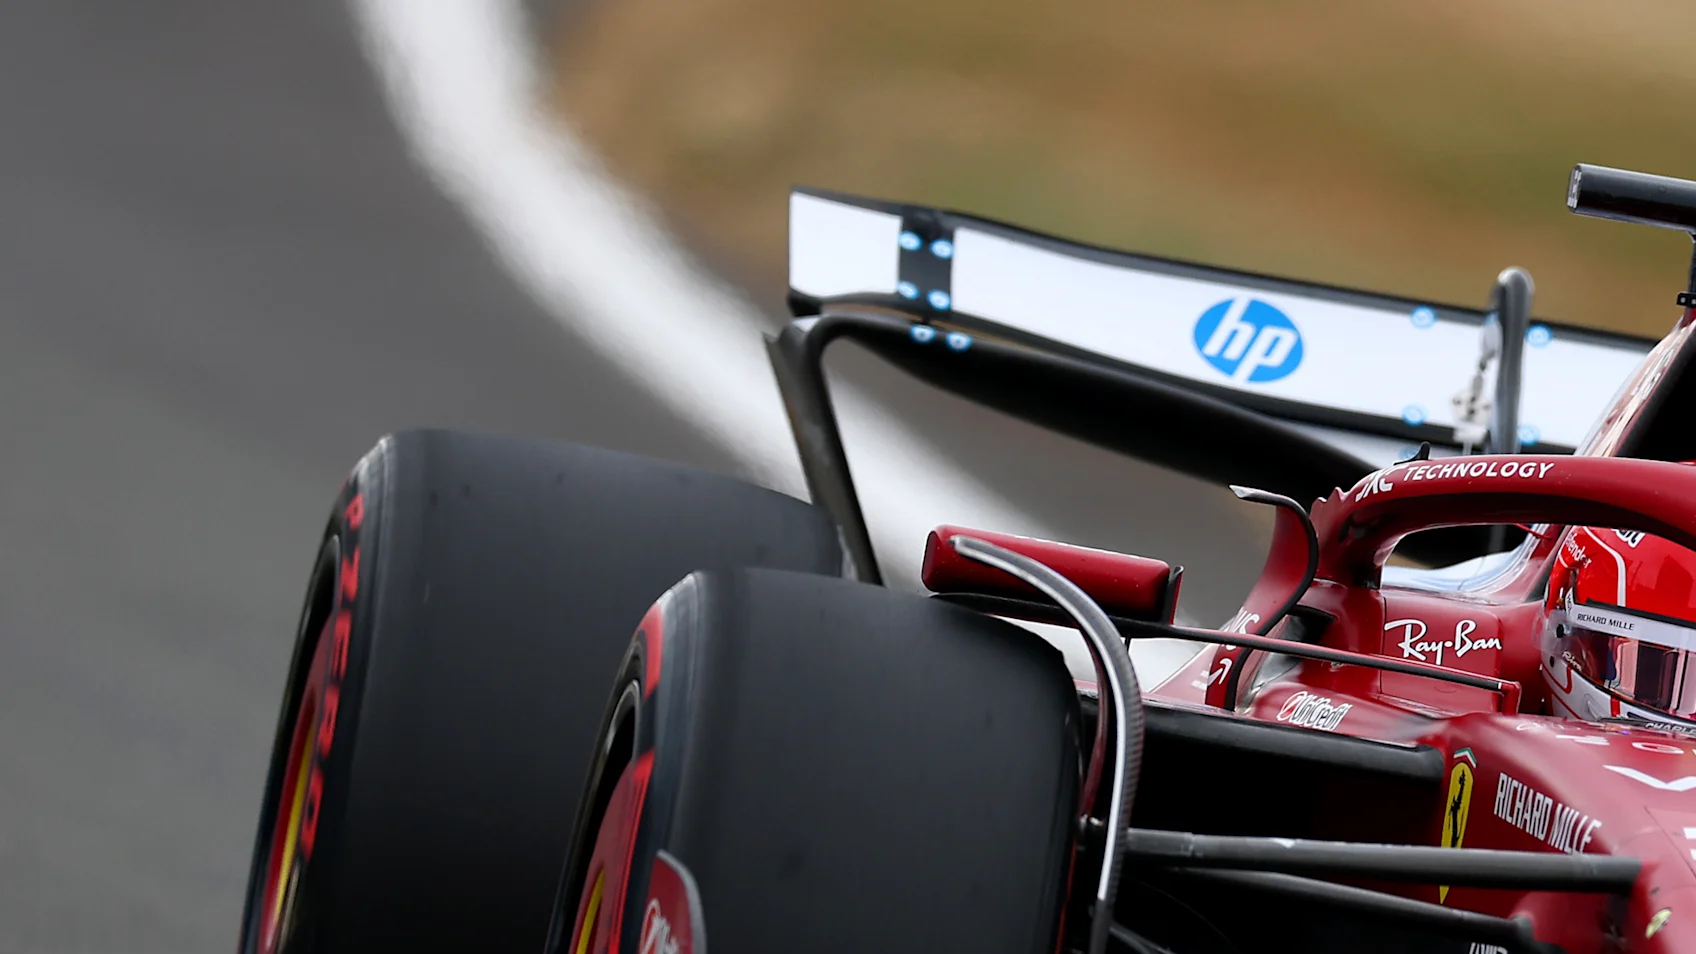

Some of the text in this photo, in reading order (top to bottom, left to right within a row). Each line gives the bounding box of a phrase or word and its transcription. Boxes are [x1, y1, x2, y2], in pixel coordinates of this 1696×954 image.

[1200, 298, 1301, 382] hp
[1403, 461, 1554, 481] TECHNOLOGY
[1576, 613, 1635, 630] RICHARD MILLE
[1493, 772, 1602, 855] RICHARD MILLE
